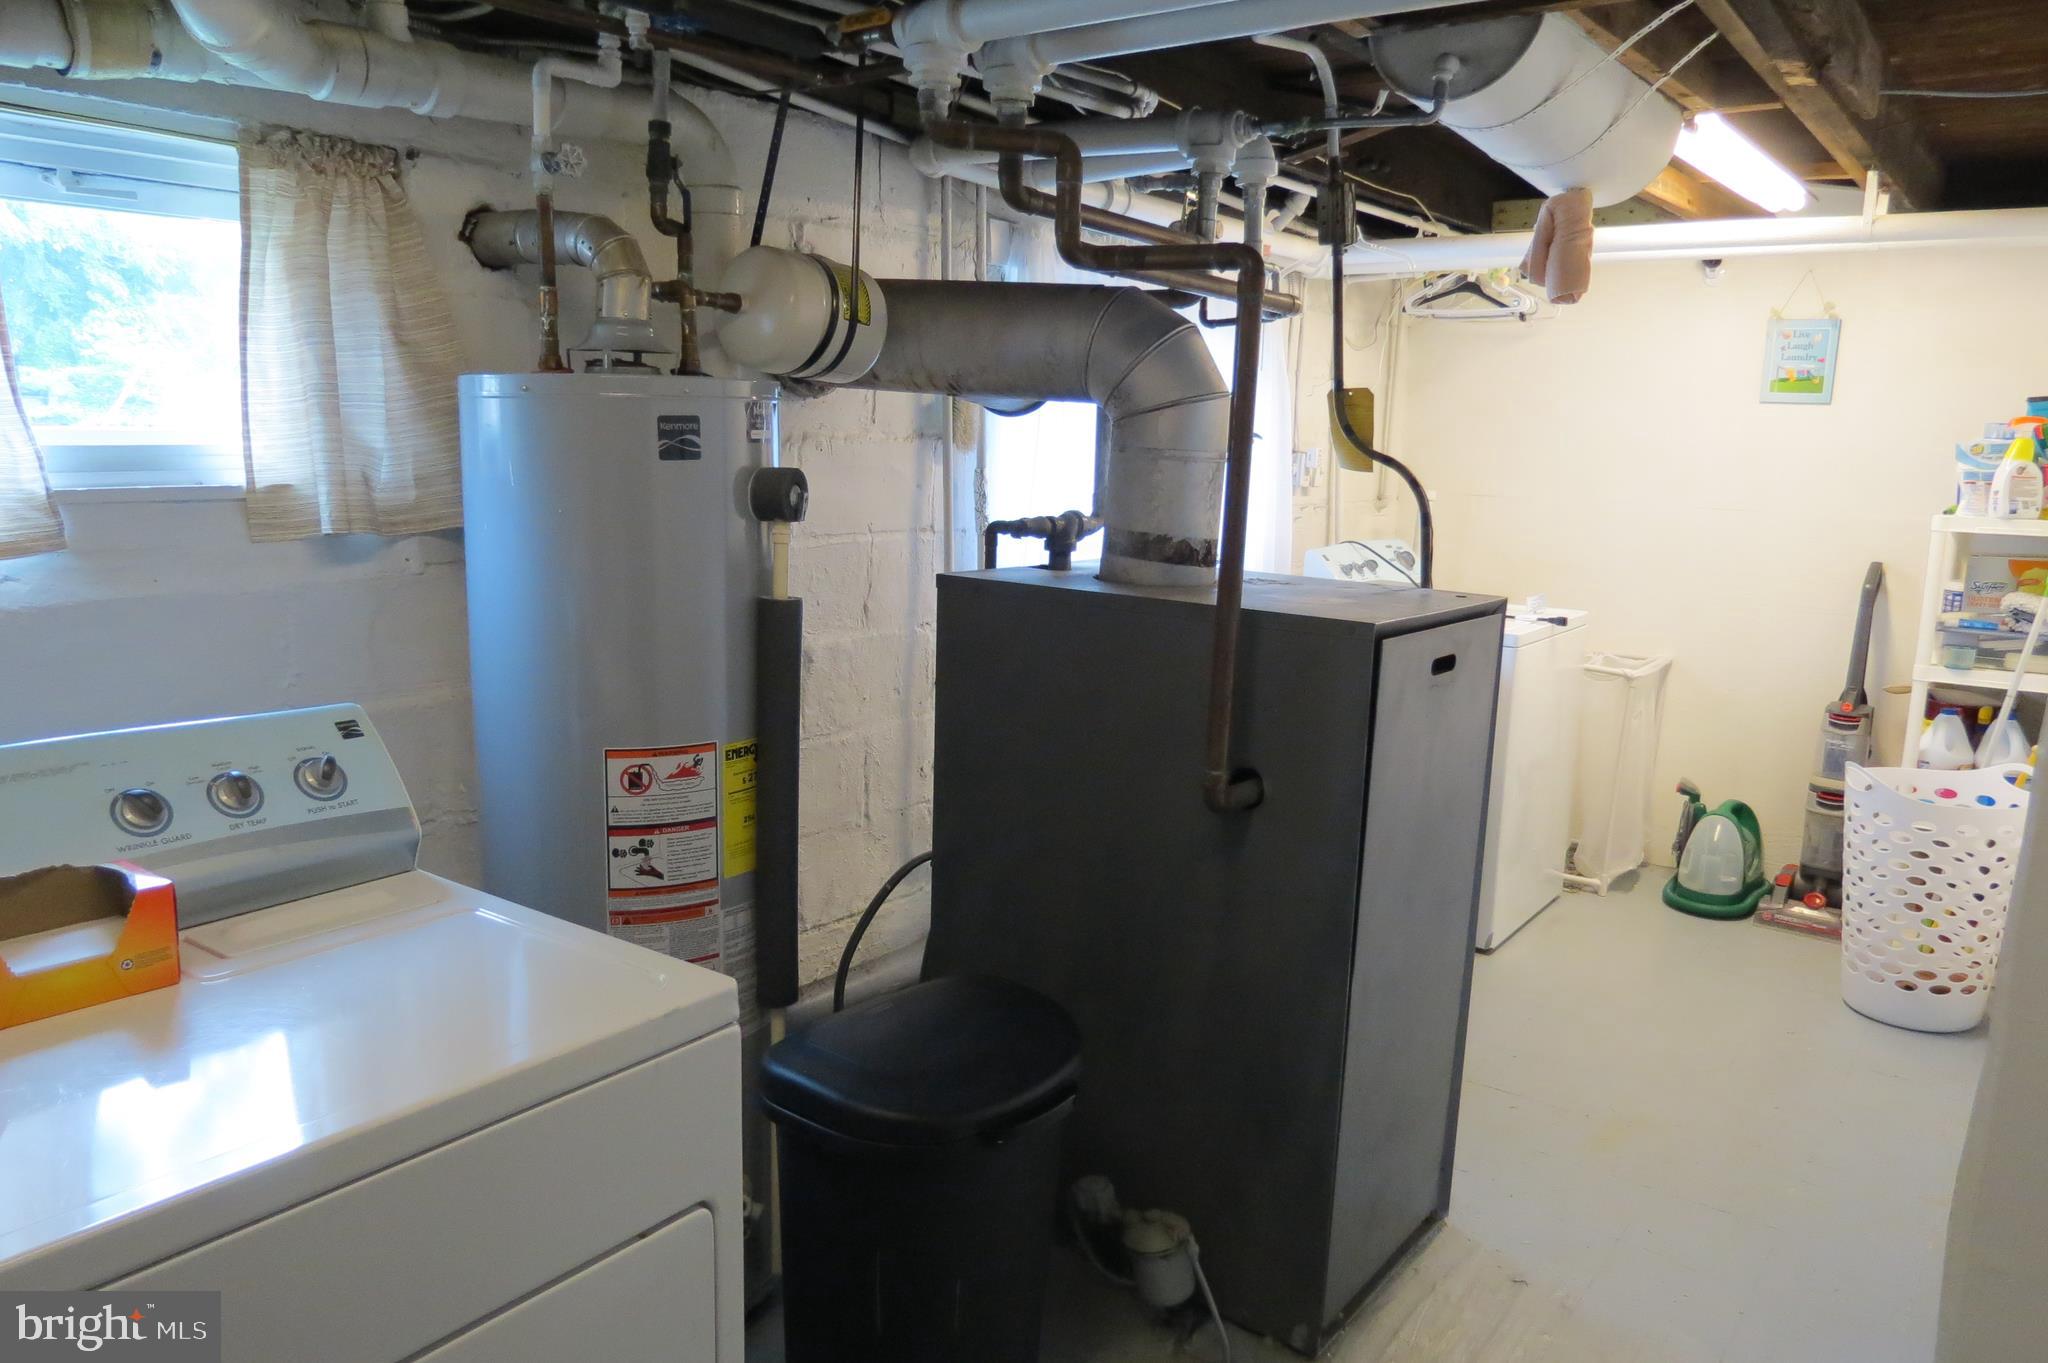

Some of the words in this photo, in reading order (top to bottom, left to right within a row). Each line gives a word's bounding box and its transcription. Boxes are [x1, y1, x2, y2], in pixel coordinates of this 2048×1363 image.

[1792, 329, 1811, 339] Live
[1787, 341, 1814, 352] Laugh
[1780, 352, 1817, 362] Laundry
[659, 422, 699, 431] Kenmore
[307, 804, 328, 815] PUSH
[337, 798, 359, 809] START
[662, 824, 690, 833] DANGER
[160, 832, 193, 845] GUARD
